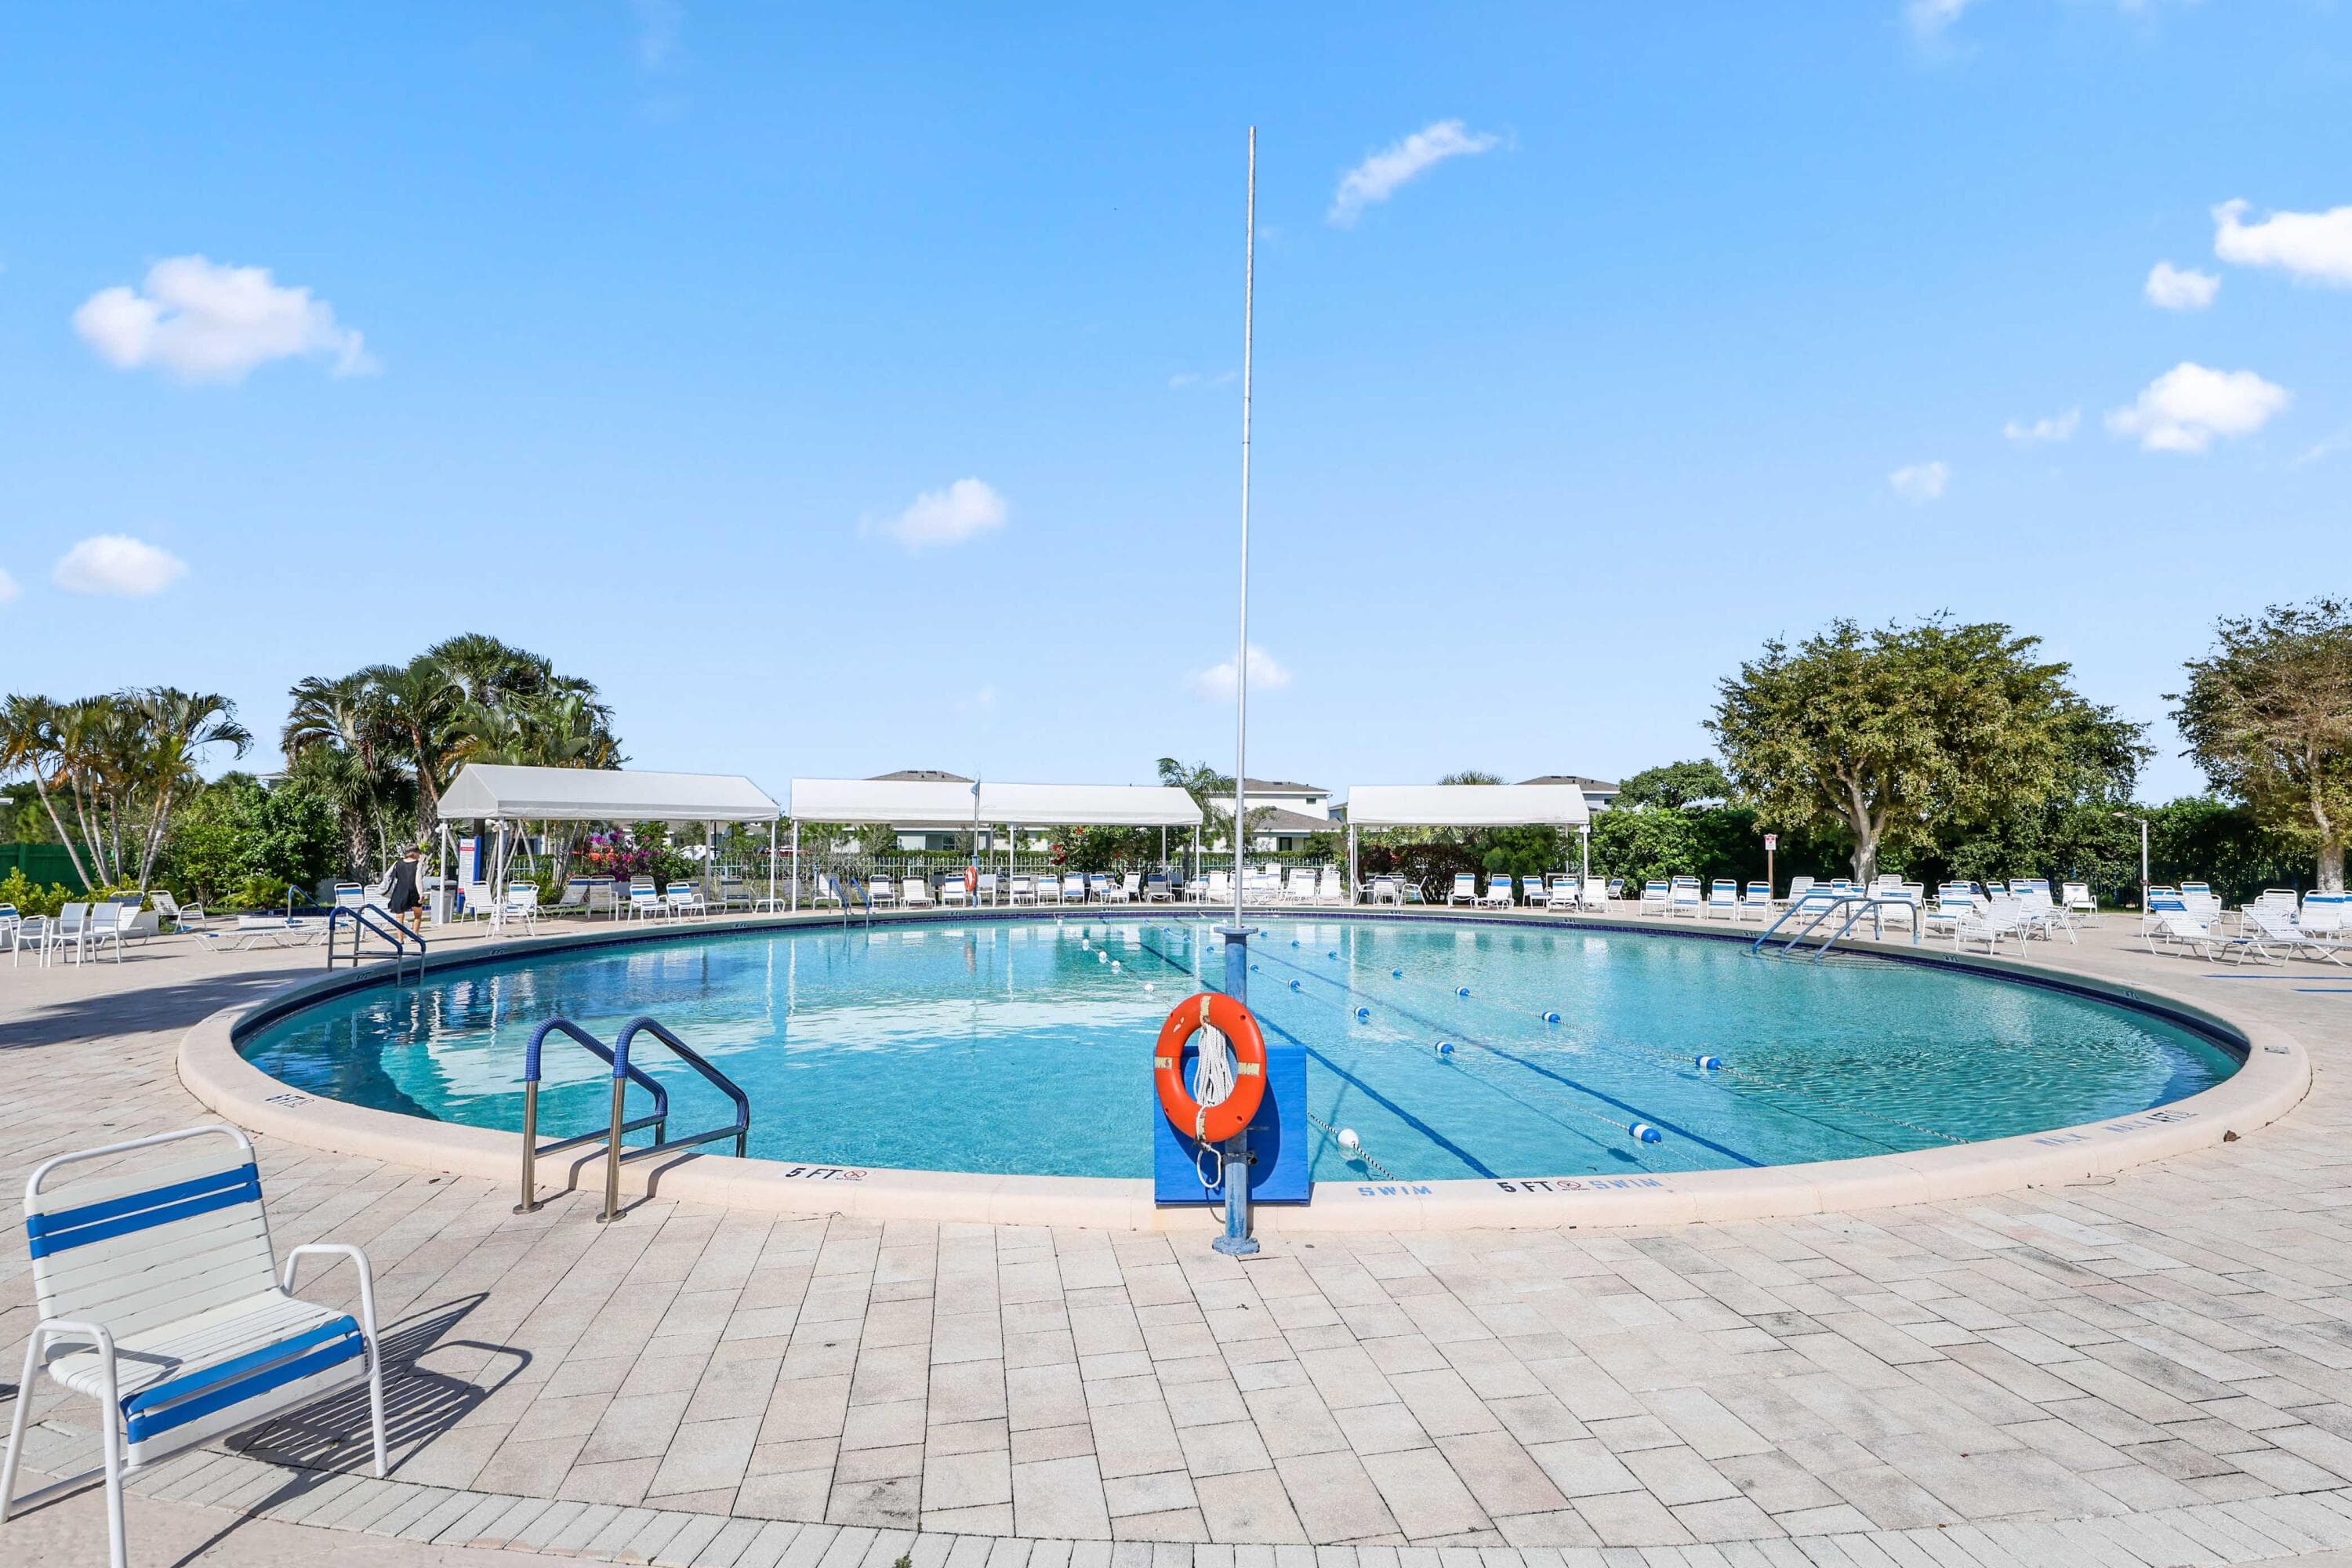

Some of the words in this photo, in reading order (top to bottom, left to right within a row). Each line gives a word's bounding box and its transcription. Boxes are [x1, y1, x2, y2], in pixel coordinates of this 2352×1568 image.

[2031, 1133, 2092, 1146] WALK
[786, 1167, 807, 1178] 5
[805, 1168, 844, 1180] FT
[1497, 1181, 1517, 1192] 5
[1520, 1181, 1554, 1192] FT
[1588, 1178, 1664, 1189] SWIM
[1357, 1185, 1433, 1196] SWIM
